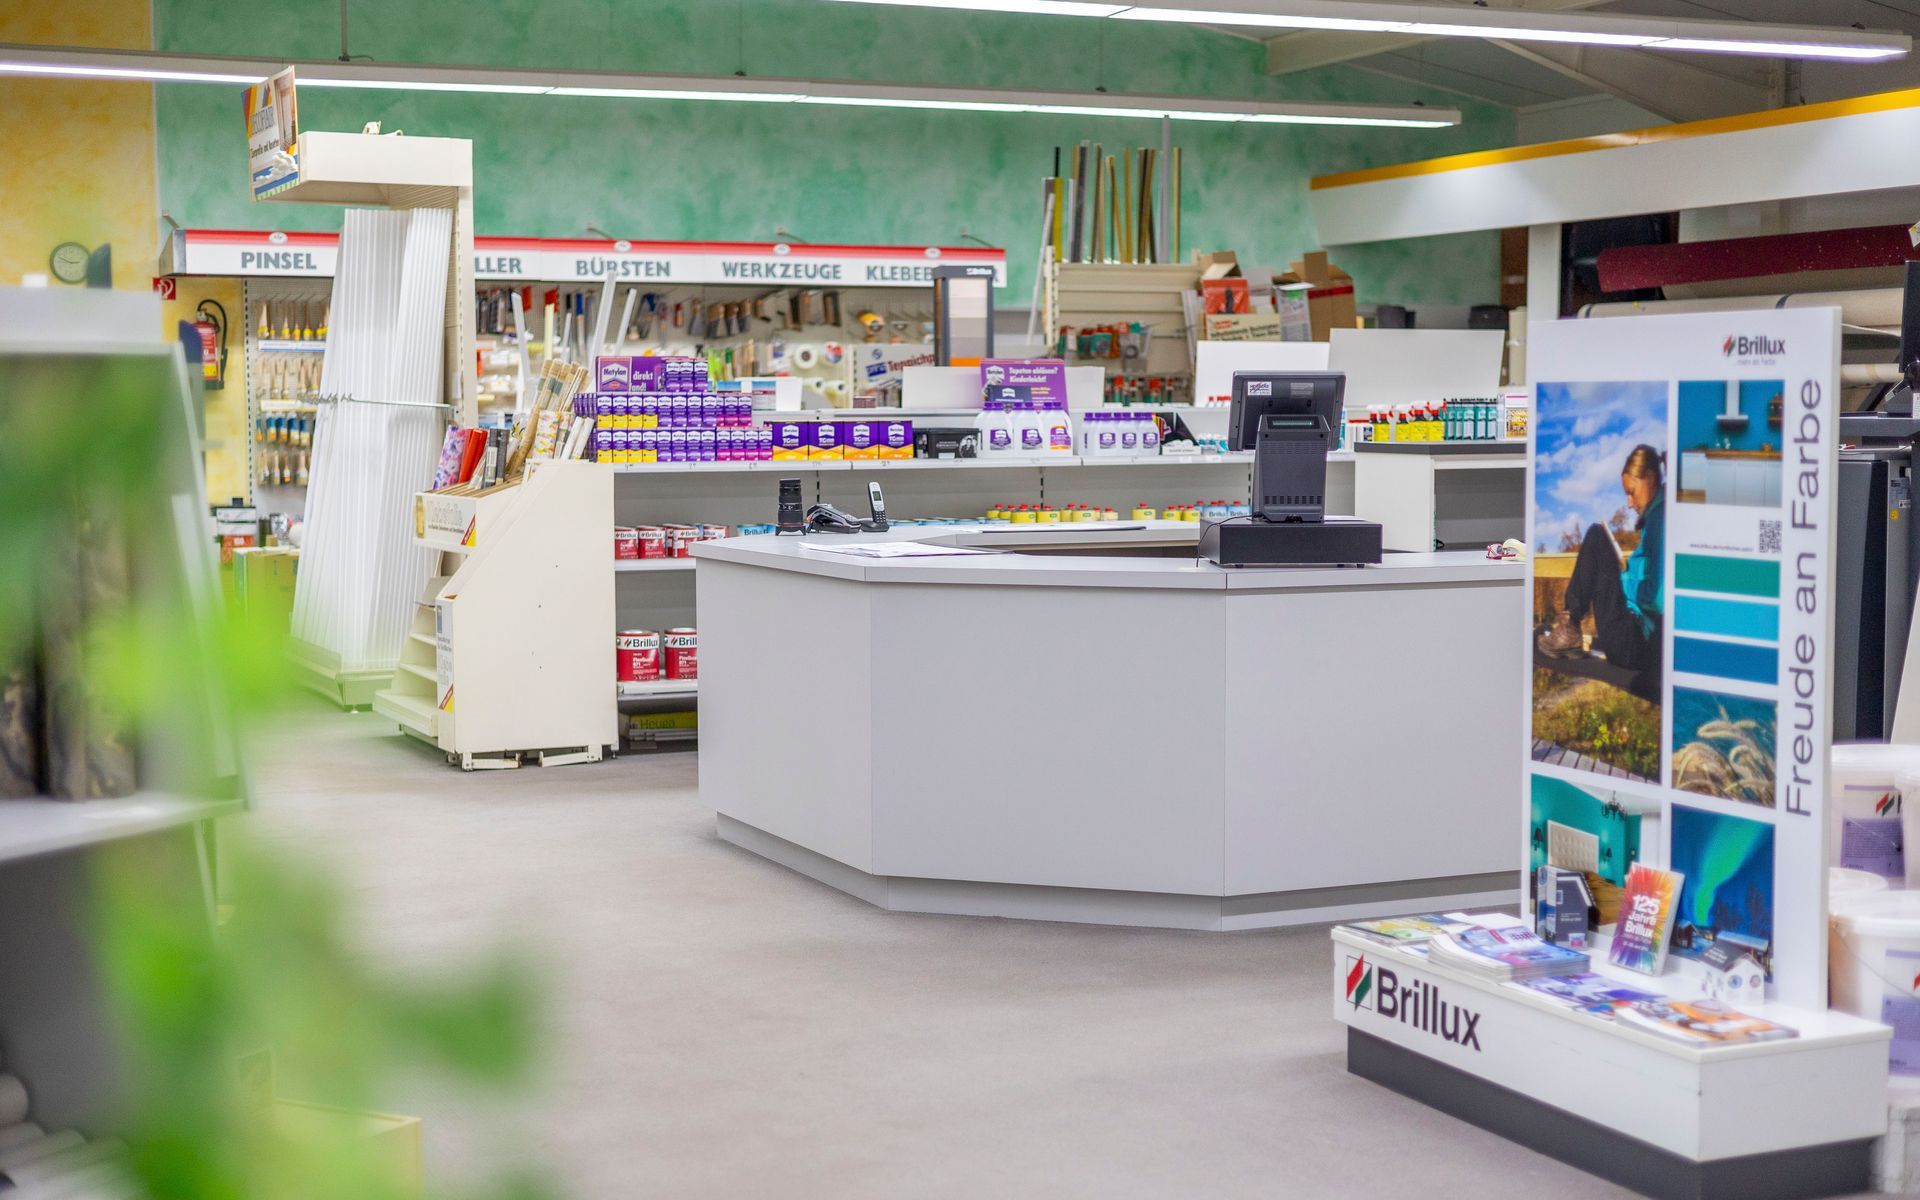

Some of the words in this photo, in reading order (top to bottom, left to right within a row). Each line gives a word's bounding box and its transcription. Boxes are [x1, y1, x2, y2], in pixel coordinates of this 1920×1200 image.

[240, 252, 317, 270] PINSEL
[474, 257, 522, 273] LLER
[576, 256, 671, 277] BÜRSTEN
[722, 262, 842, 279] WERKZEUGE
[866, 265, 933, 281] KLEBEB
[1738, 335, 1786, 355] Brillux
[603, 368, 627, 377] Metylan
[632, 371, 653, 380] direkt
[1791, 379, 1822, 530] Farbe
[1795, 552, 1817, 614] an
[632, 638, 658, 647] Brillu
[679, 637, 697, 646] Brill
[1786, 633, 1816, 817] Freude
[1633, 894, 1660, 915] 125
[1628, 910, 1657, 926] Jahre
[1625, 920, 1654, 939] Brillux
[1377, 966, 1482, 1052] Brillux
